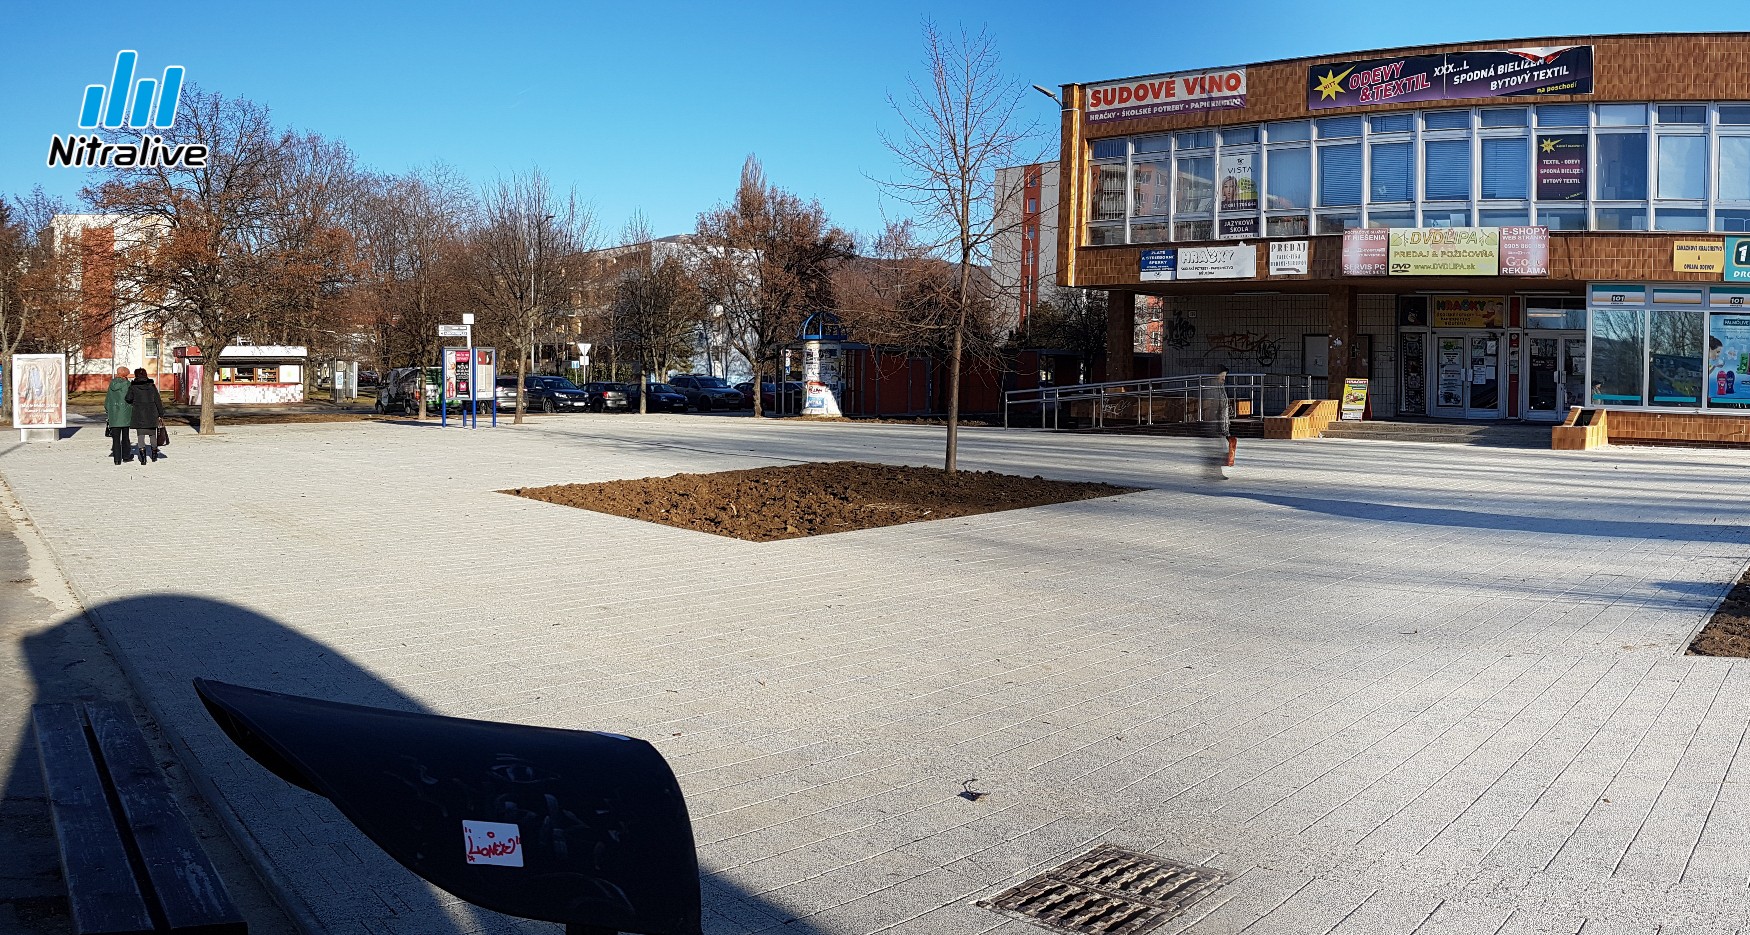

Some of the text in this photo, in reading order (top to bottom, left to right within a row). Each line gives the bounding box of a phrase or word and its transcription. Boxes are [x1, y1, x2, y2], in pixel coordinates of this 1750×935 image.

[1349, 60, 1405, 90] ODEVY
[1453, 64, 1495, 85] SPODNÁ
[1490, 65, 1570, 91] BYTOVÝ TEXTIL
[1089, 71, 1242, 108] SUDOVÉ VÍNO
[1536, 81, 1578, 94] na poschodí
[1089, 111, 1117, 121] HRAČKY
[1121, 105, 1152, 117] ŠKOLSKÉ
[1153, 103, 1184, 114] POTREBY
[1227, 166, 1253, 174] VISTA
[1224, 219, 1254, 227] JAZYKOVÁ
[1230, 225, 1249, 233] ŠKOLA
[1502, 227, 1547, 236] E-SHOPY
[1271, 242, 1306, 253] PREDAJ
[1343, 263, 1386, 271] SERVIS PC
[1437, 298, 1487, 312] HRAČKY
